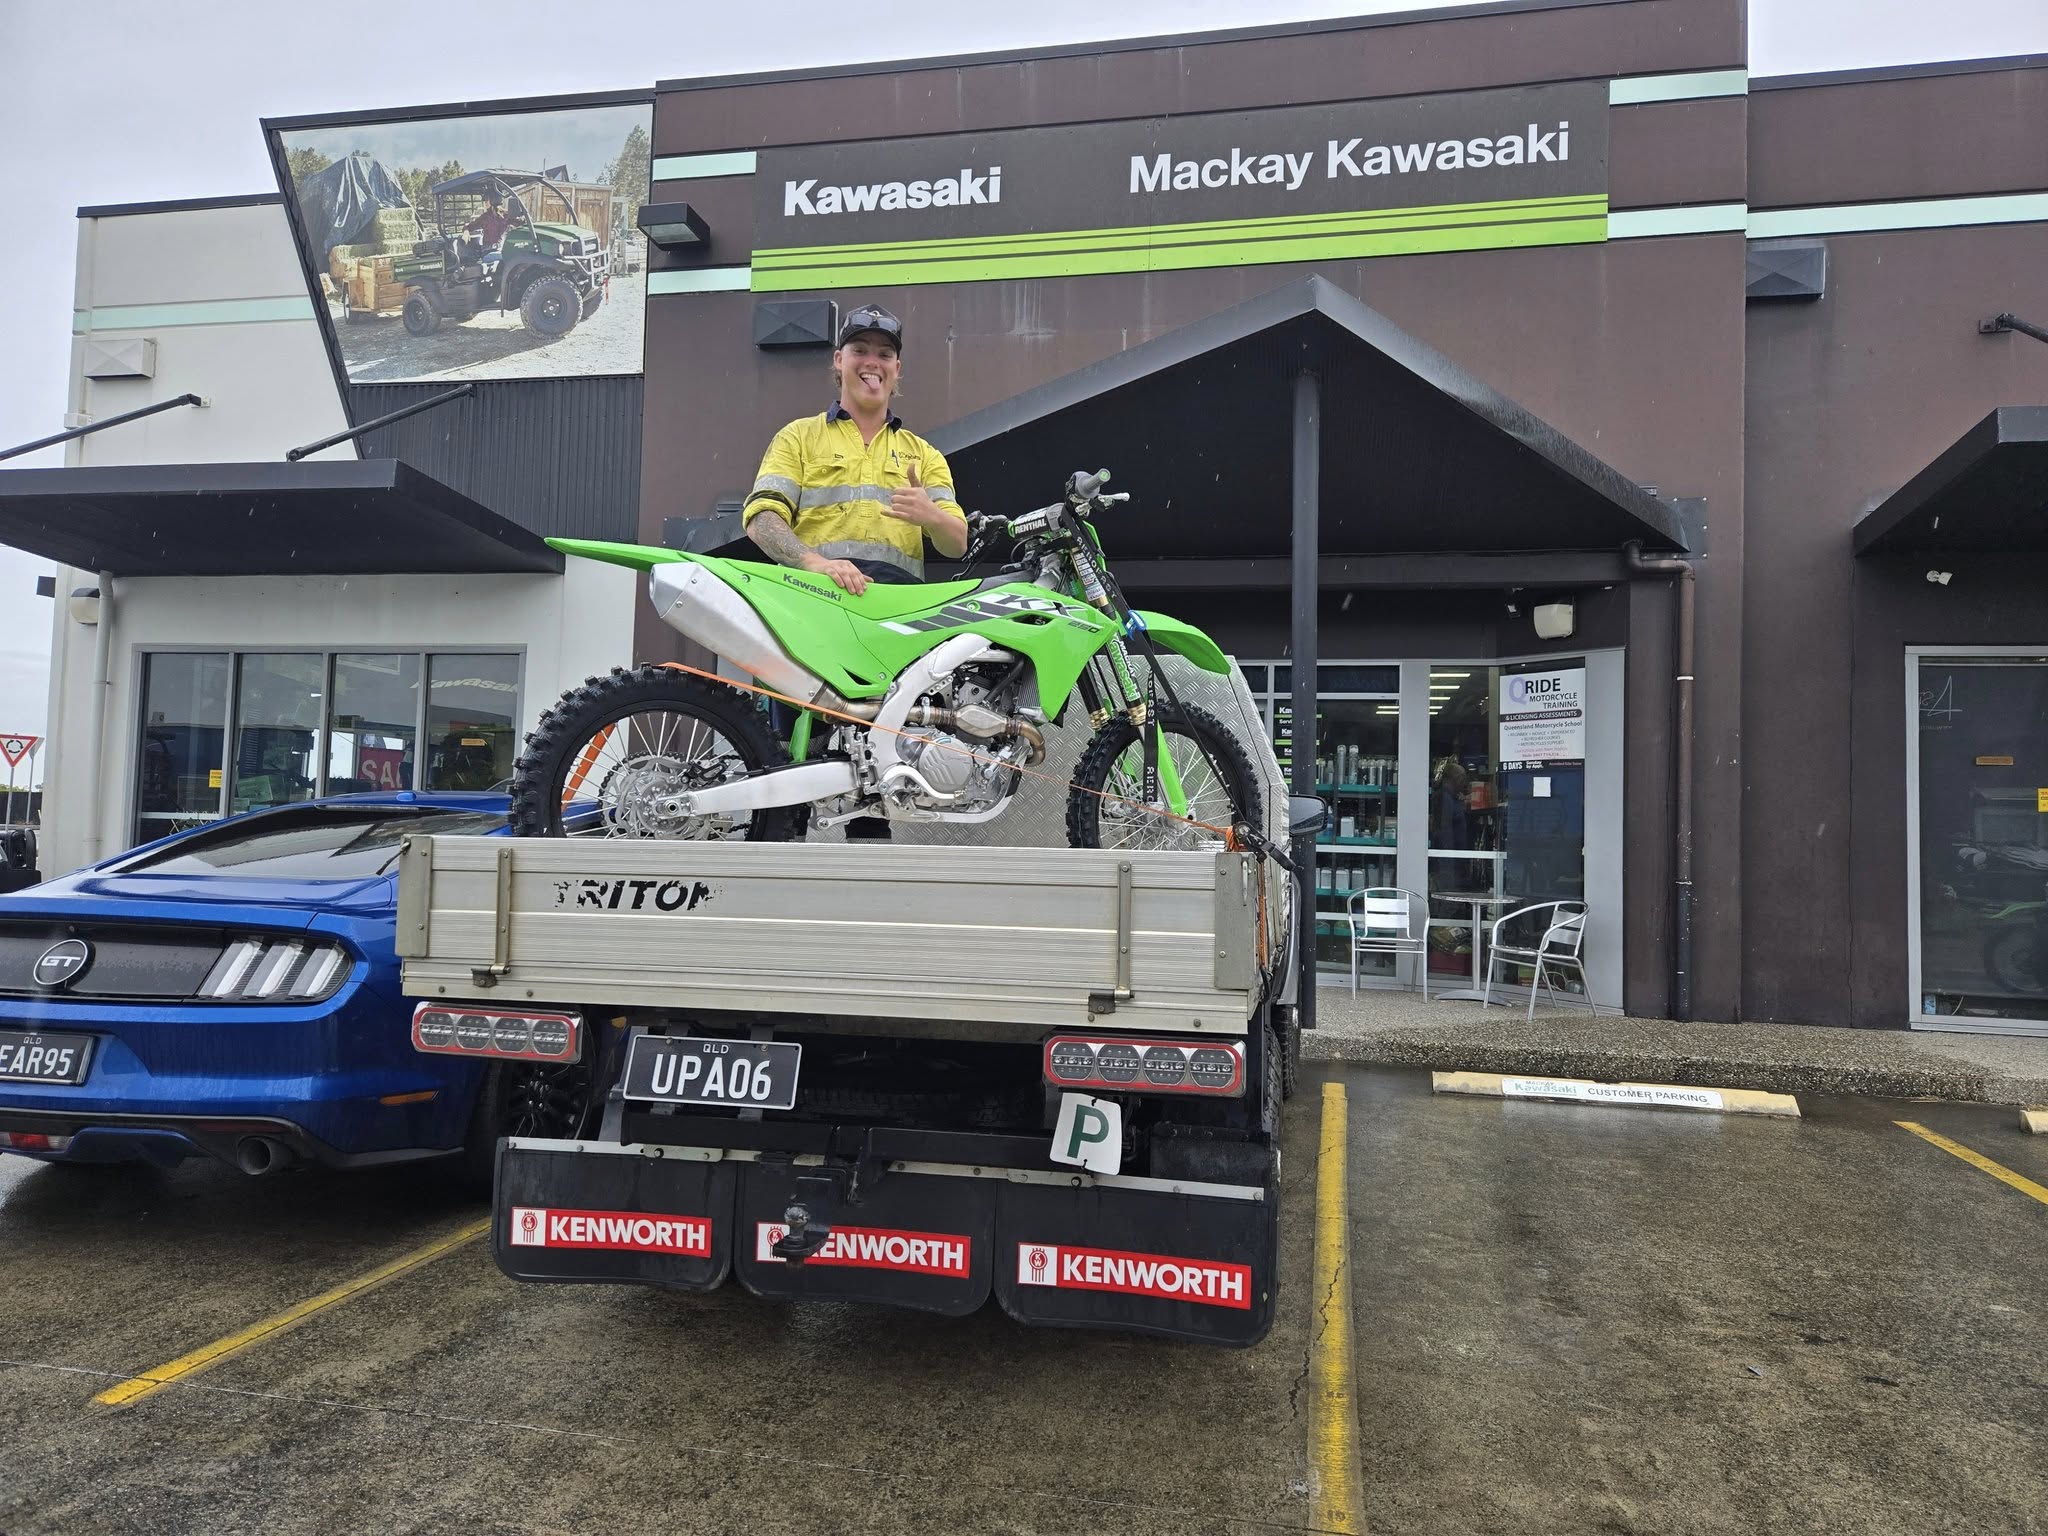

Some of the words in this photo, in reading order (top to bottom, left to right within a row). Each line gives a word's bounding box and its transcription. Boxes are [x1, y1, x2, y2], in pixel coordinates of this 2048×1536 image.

[1130, 147, 1315, 192] Mackay
[1327, 121, 1570, 179] Kawasaki
[784, 166, 1001, 217] Kawasaki
[1015, 518, 1047, 534] RENTHAL
[783, 573, 842, 602] Kawasaki
[1068, 619, 1100, 634] 250
[1119, 639, 1136, 677] MACKAY
[1529, 692, 1578, 702] MOTORCYCLE
[1543, 700, 1578, 709] TRAINING
[1510, 712, 1538, 721] LICENSING
[1539, 710, 1577, 718] ASSESSMENTS
[1504, 723, 1534, 731] Queensland
[1508, 762, 1523, 770] DAYS
[41, 956, 81, 967] GT
[23, 1036, 42, 1045] QLD
[703, 1043, 730, 1054] QLD
[651, 1053, 772, 1101] UPA06
[1514, 1083, 1577, 1094] Kawasaki
[1587, 1087, 1652, 1099] CUSTOMER
[1655, 1091, 1708, 1103] PARKING
[1066, 1104, 1110, 1159] P
[551, 1215, 705, 1250] KENWORTH
[812, 1232, 963, 1270] ENWORTH
[1063, 1254, 1242, 1301] KENWORTH
